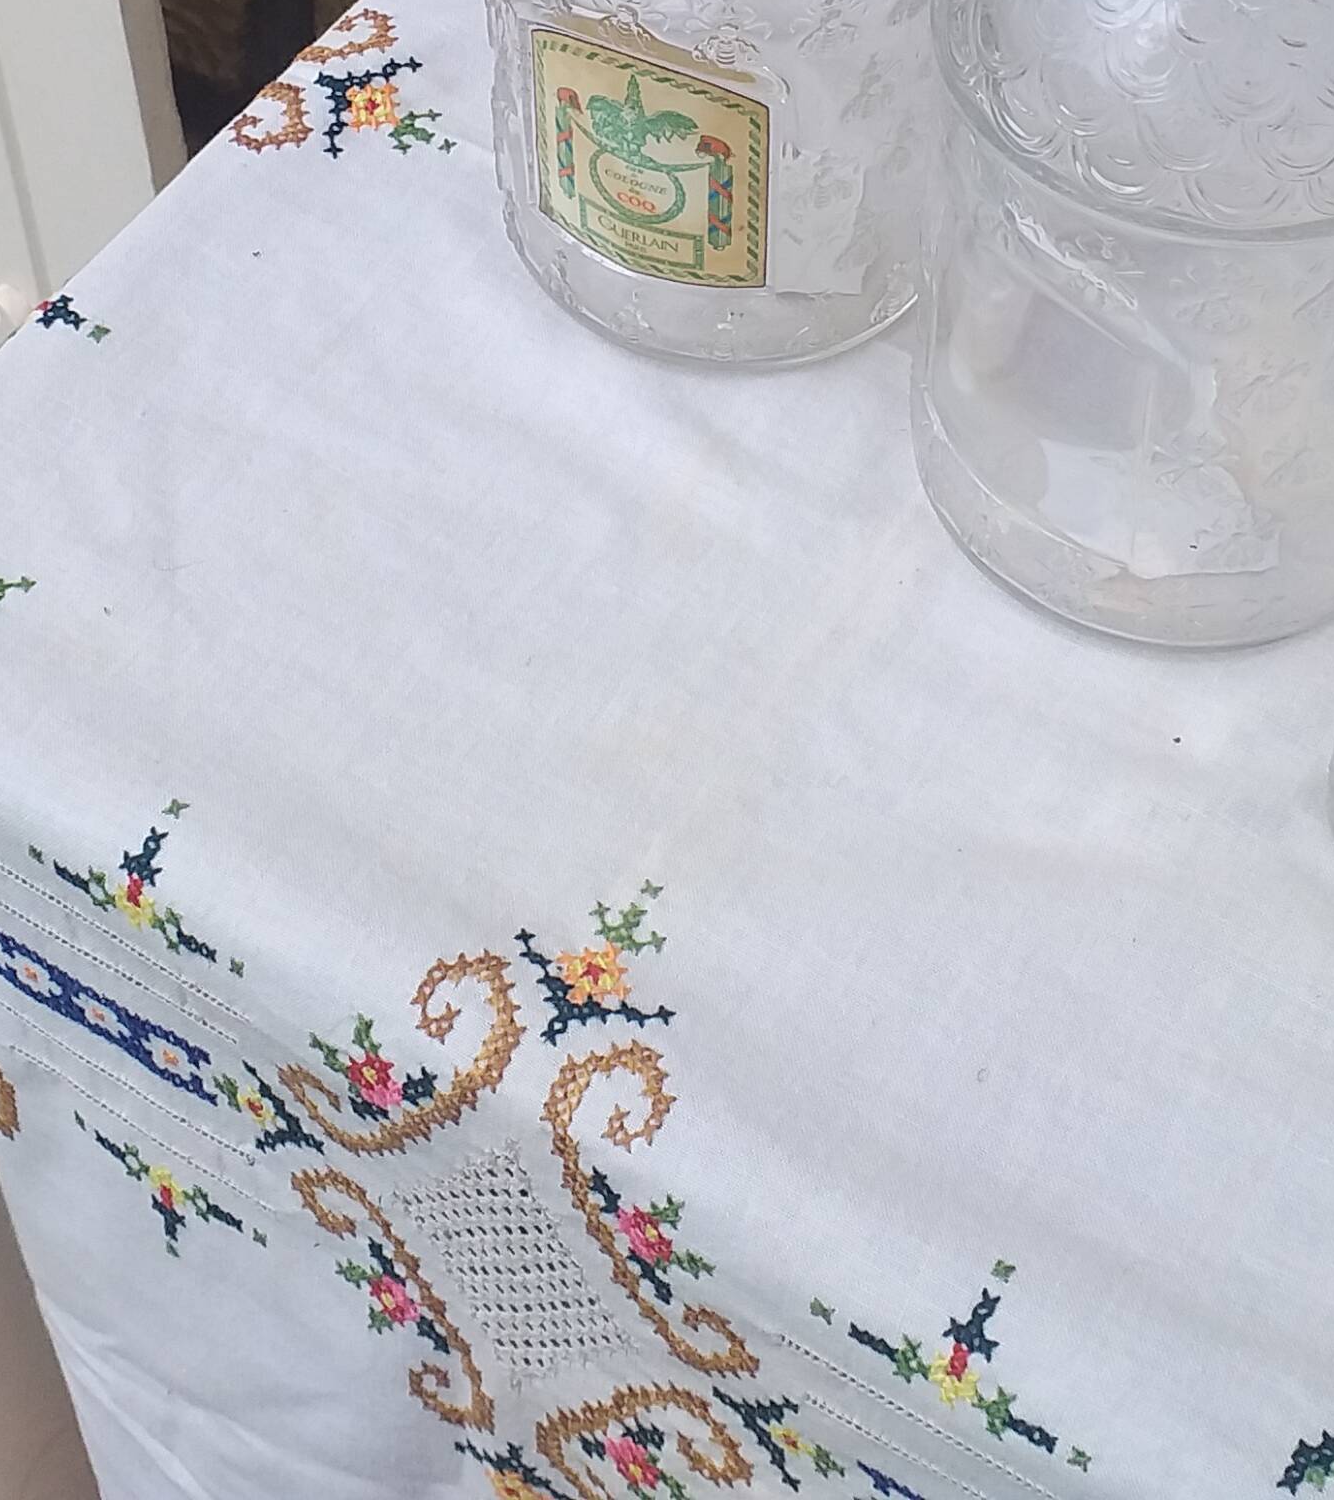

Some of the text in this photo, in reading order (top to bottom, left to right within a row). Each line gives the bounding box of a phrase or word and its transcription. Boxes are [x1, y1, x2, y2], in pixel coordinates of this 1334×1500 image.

[605, 169, 667, 195] COLOGNE
[617, 192, 656, 213] COQ
[598, 215, 679, 252] GUERLAIN
